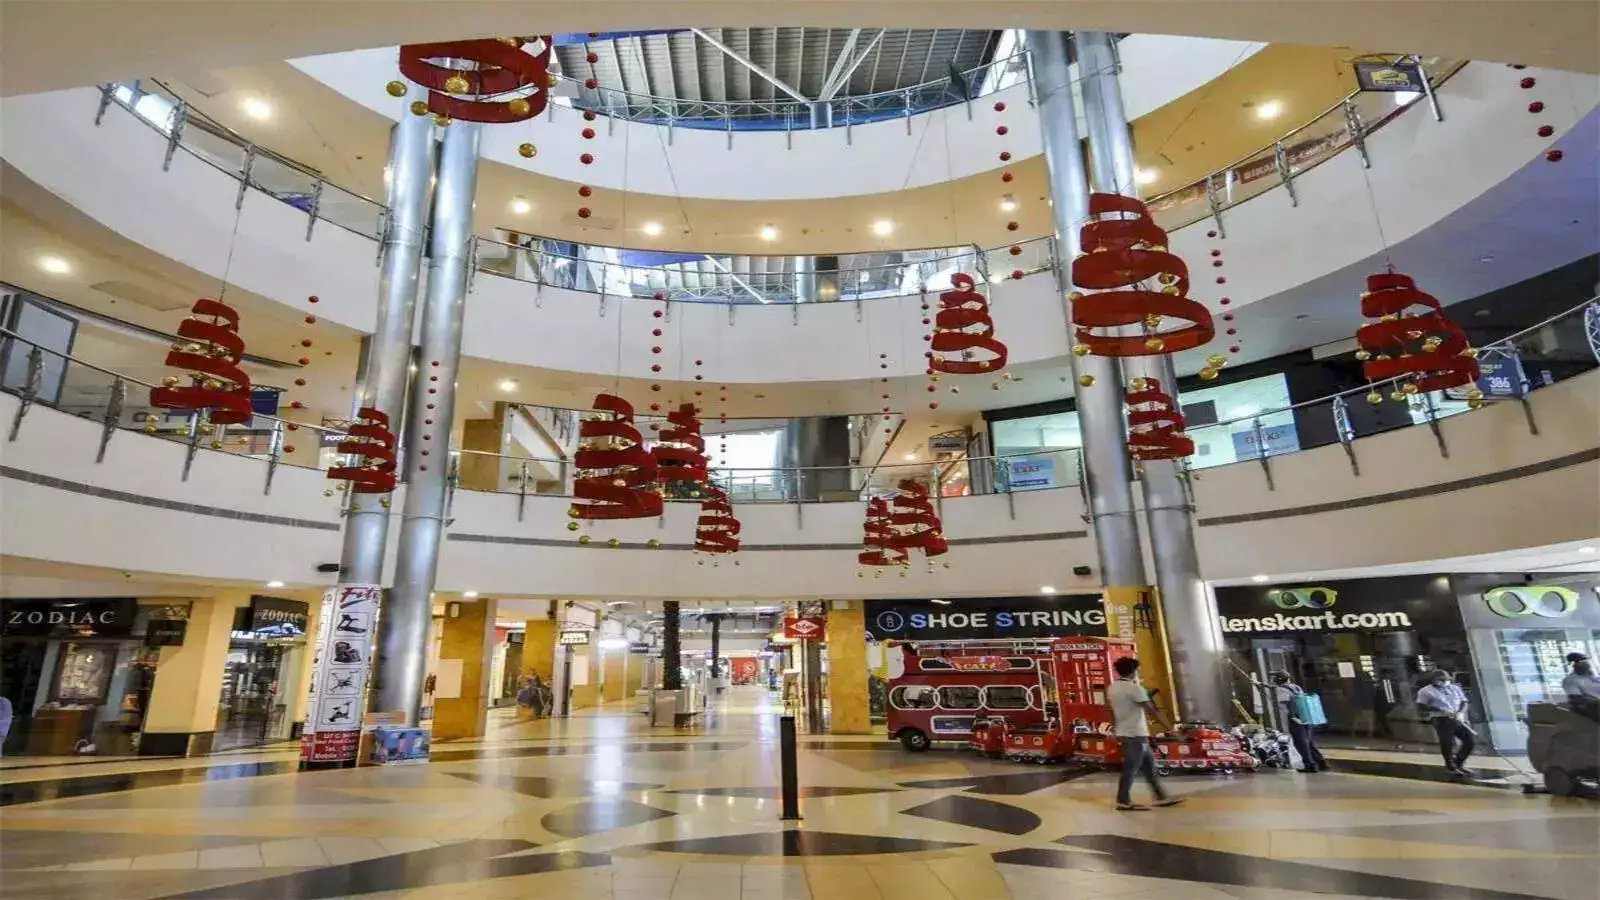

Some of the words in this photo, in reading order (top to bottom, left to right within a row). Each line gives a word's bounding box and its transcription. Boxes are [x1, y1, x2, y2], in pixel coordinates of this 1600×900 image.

[8, 610, 116, 625] ZODIAC
[260, 608, 304, 624] ZODIAC
[910, 612, 989, 629] SHOE
[996, 609, 1106, 627] STRING
[1221, 611, 1410, 632] lenskart.com
